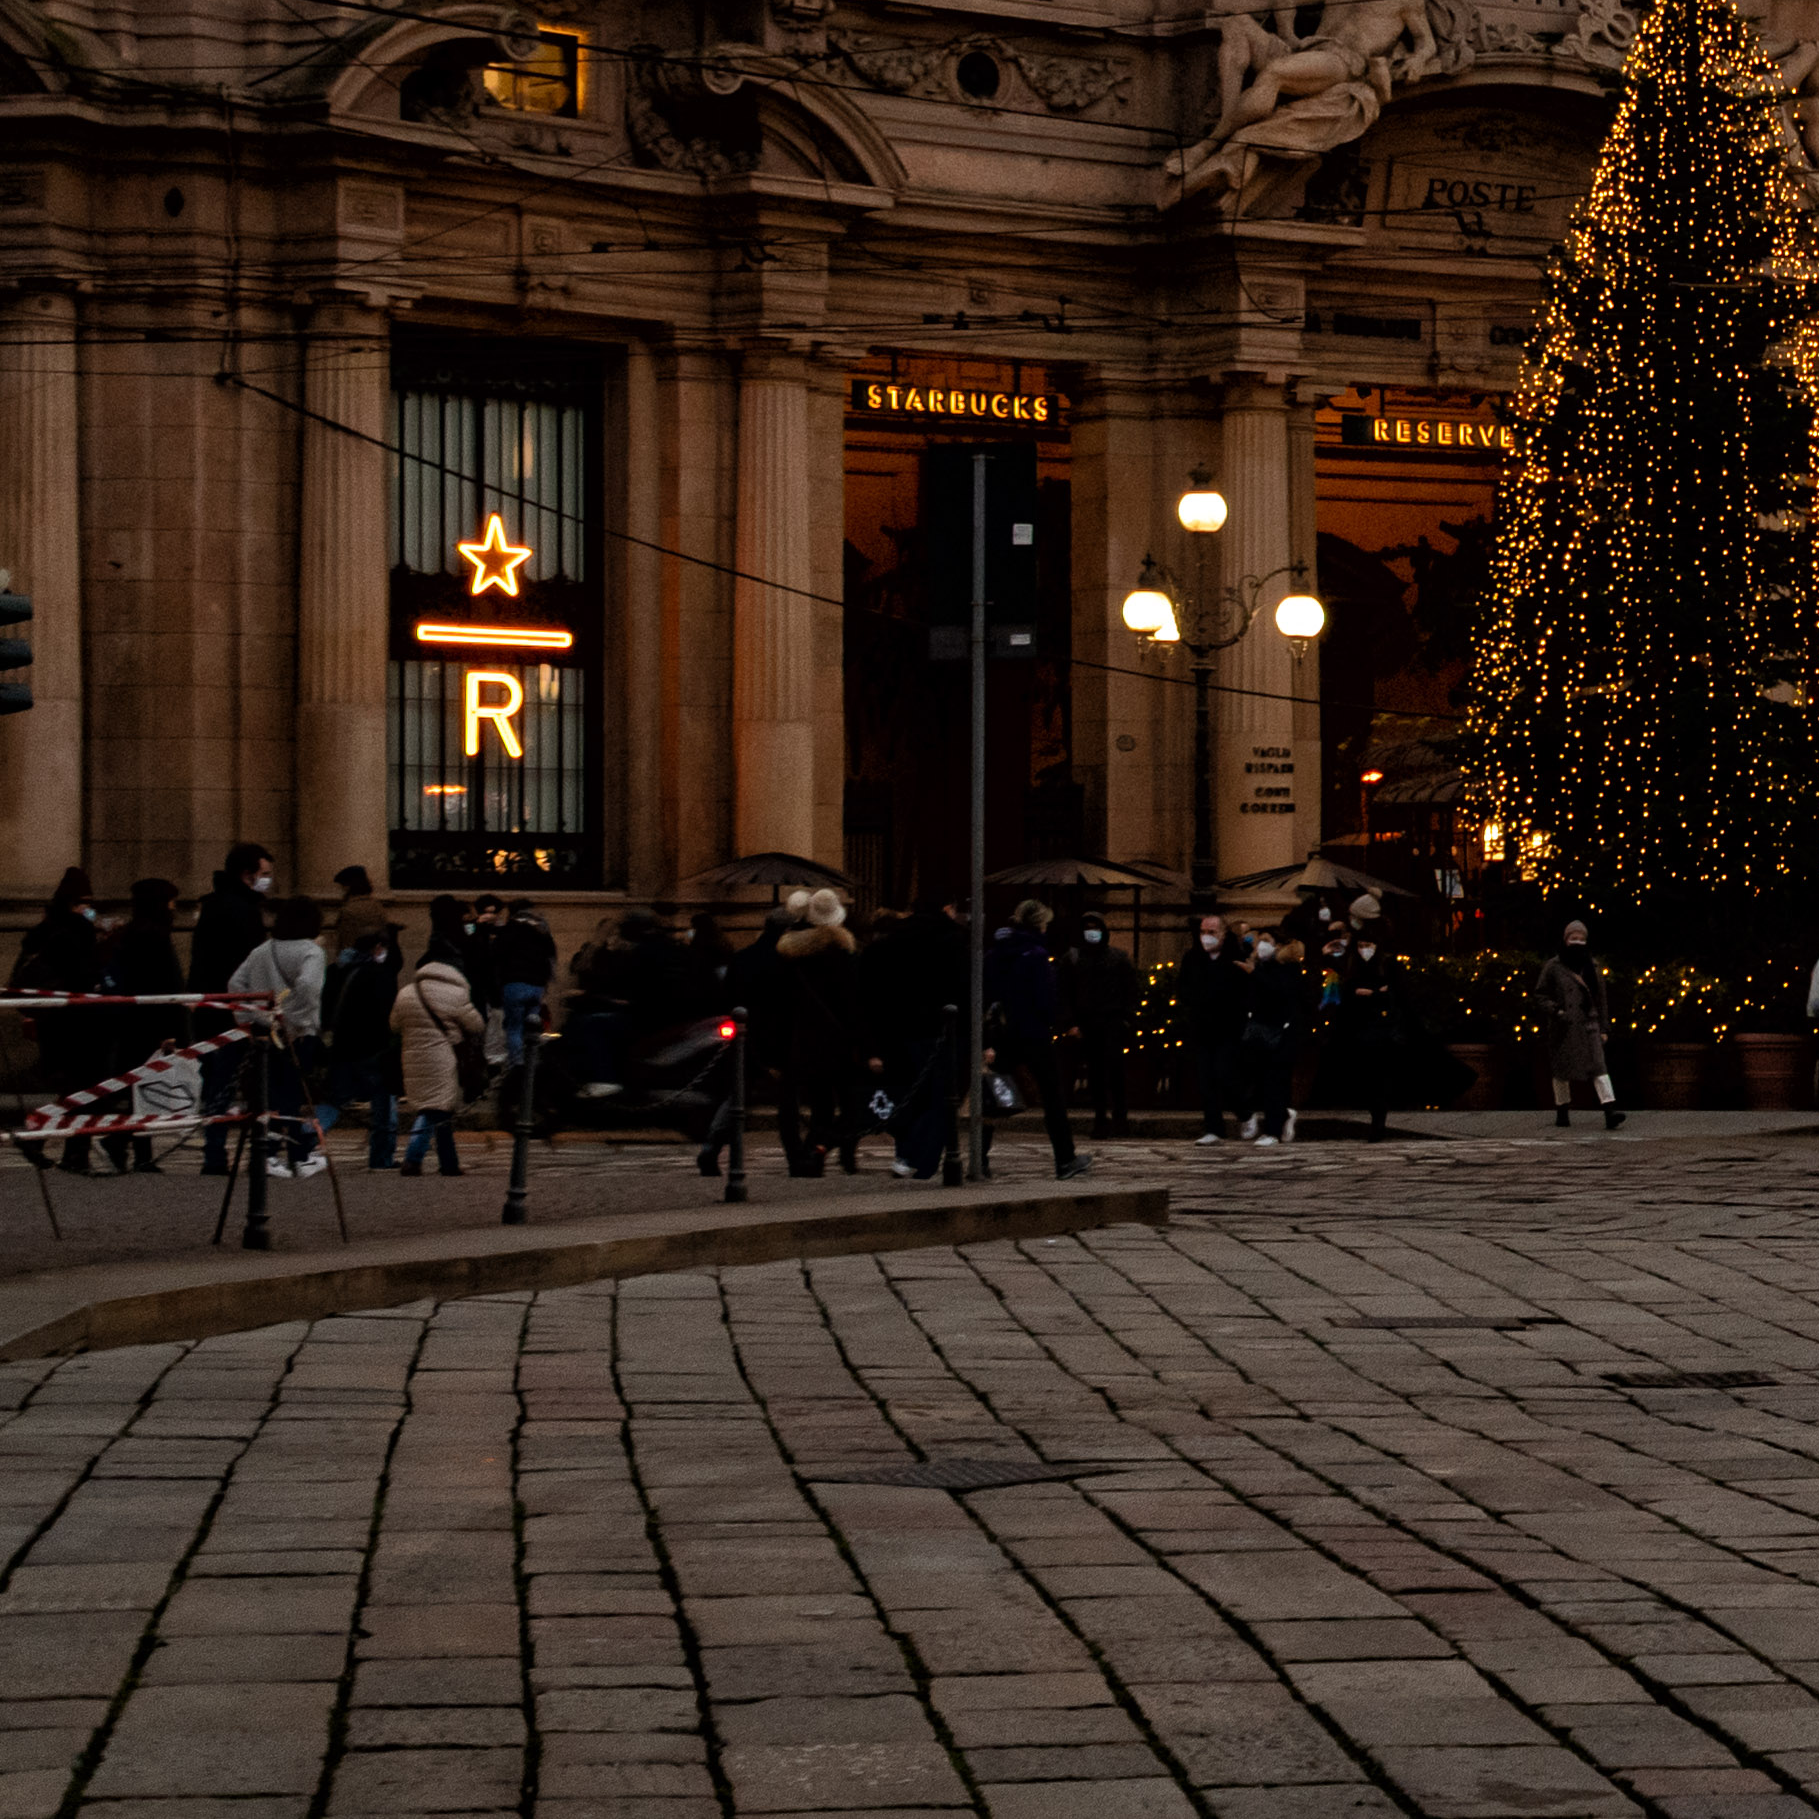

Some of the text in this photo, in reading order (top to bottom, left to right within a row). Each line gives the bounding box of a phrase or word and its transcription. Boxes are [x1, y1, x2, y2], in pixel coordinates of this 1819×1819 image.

[1422, 178, 1536, 212] POSTE
[868, 384, 1048, 422] STARBUCKS
[1373, 418, 1515, 448] RESERVE
[465, 669, 523, 759] R
